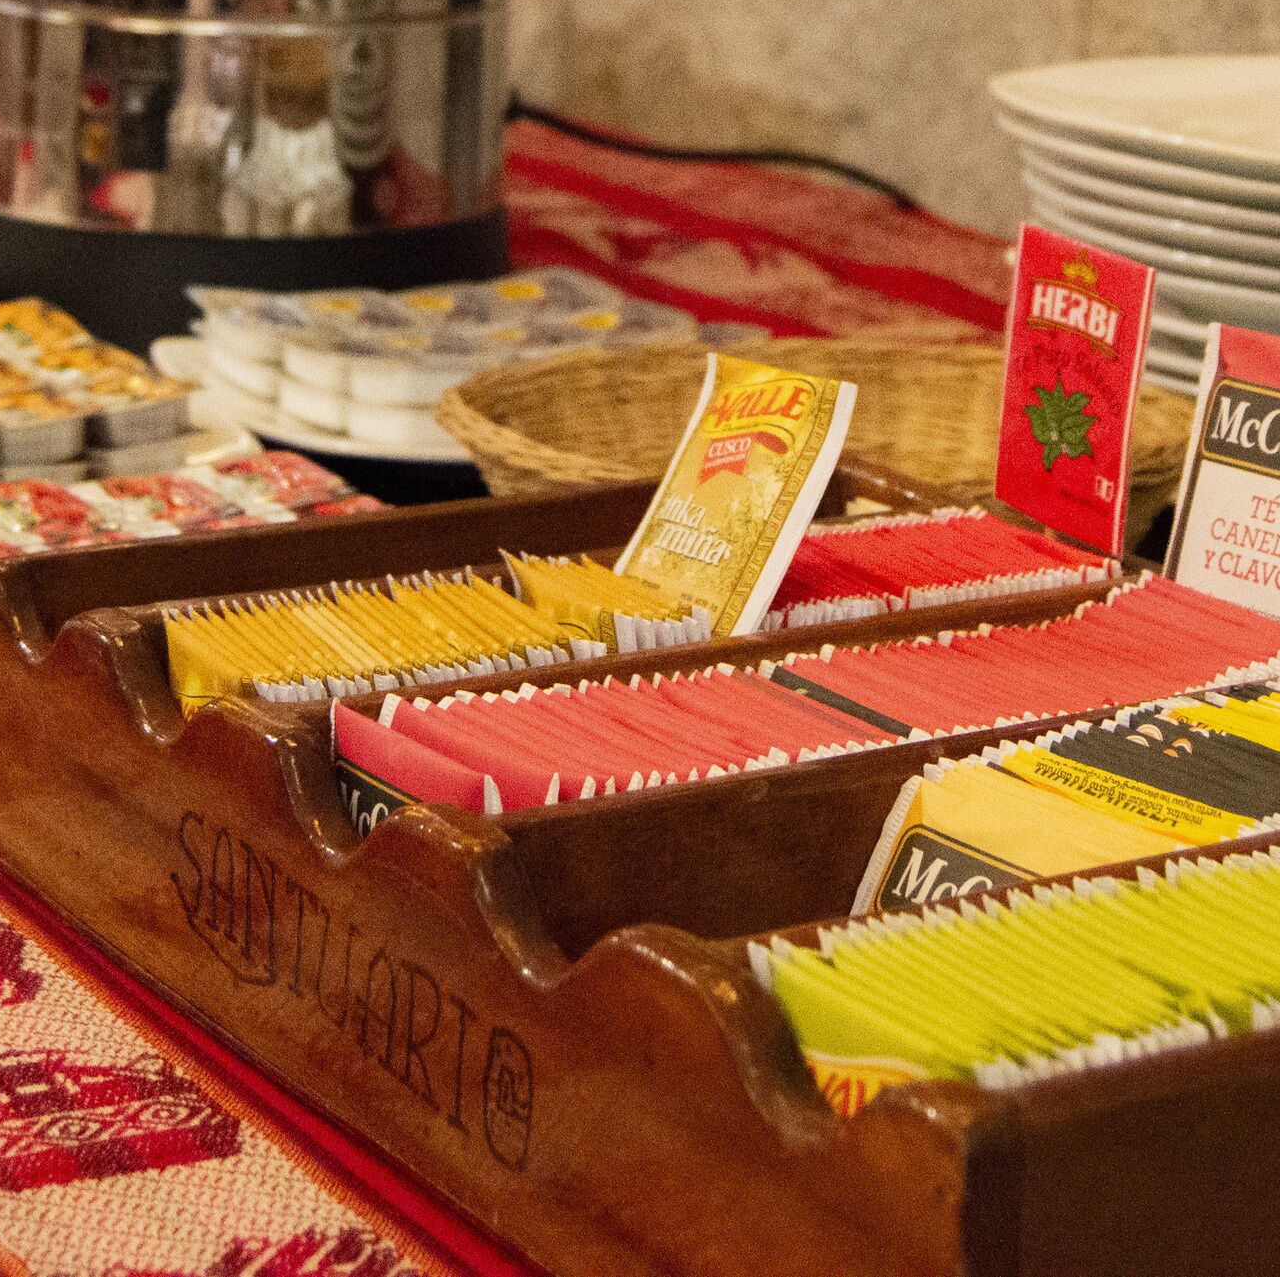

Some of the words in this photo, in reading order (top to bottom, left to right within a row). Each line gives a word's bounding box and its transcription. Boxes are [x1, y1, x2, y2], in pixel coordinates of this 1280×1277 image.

[1031, 283, 1120, 346] HERBI
[709, 385, 813, 429] VILLE
[707, 436, 752, 459] CUSCO
[1250, 494, 1280, 524] TÉ
[1203, 549, 1216, 569] Y
[171, 810, 534, 1173] SANTUARIO
